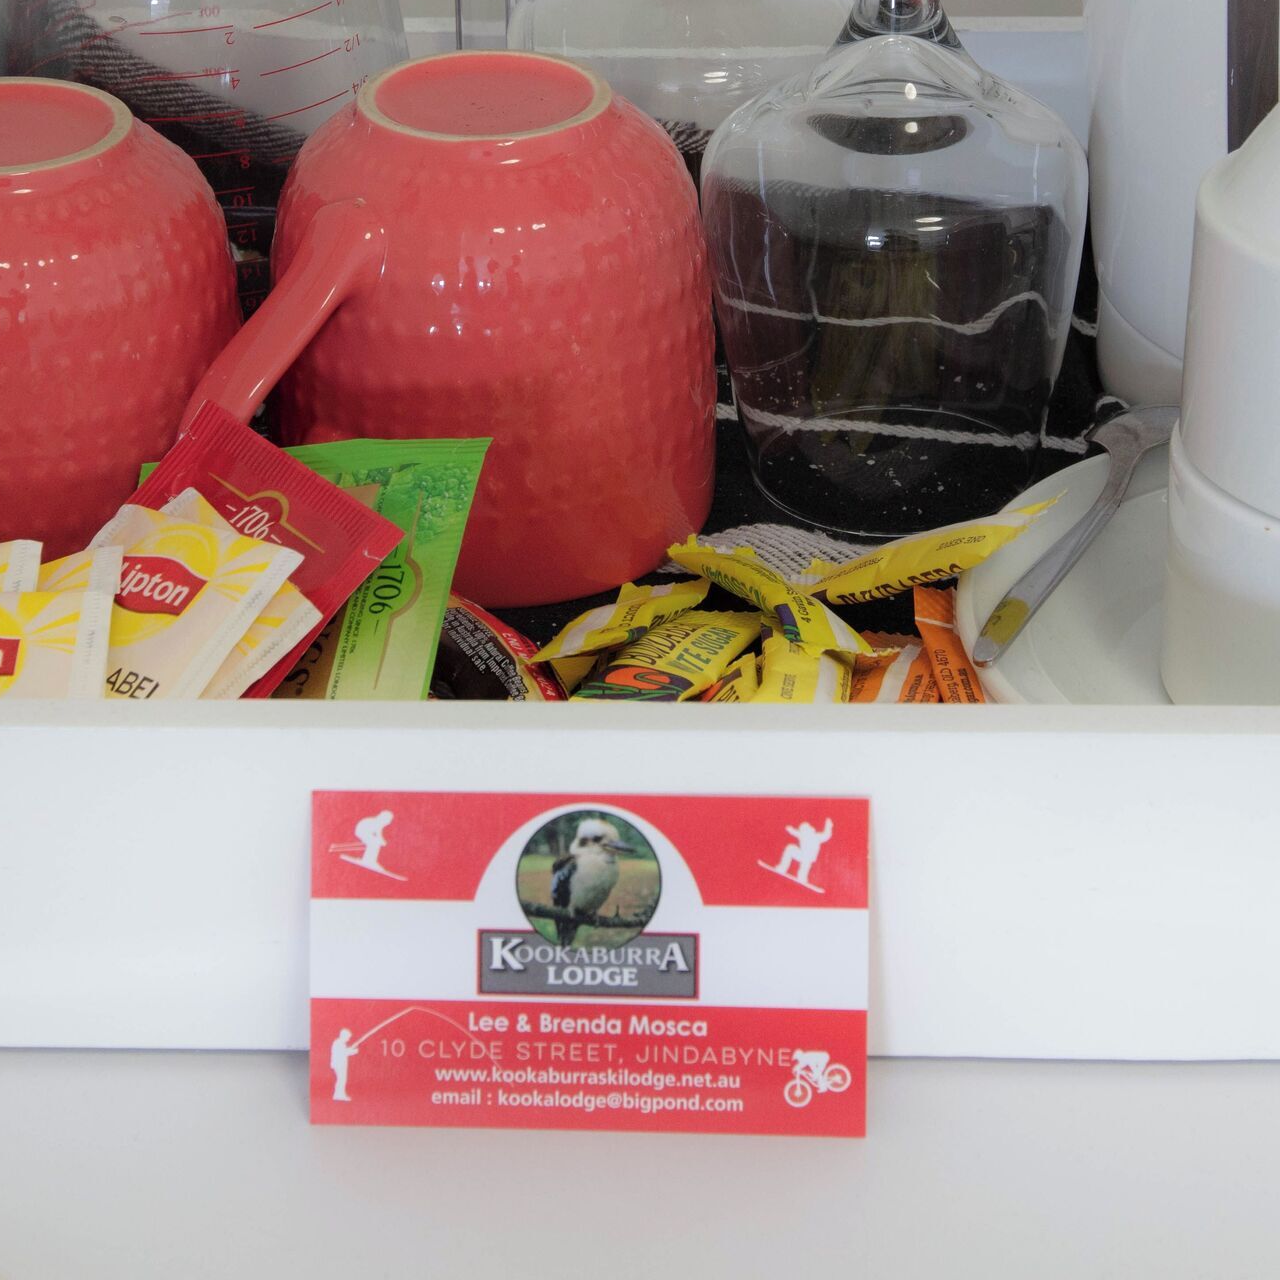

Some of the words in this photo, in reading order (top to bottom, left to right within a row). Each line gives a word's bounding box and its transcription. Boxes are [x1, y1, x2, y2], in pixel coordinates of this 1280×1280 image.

[225, 32, 235, 46] 2
[344, 32, 361, 53] 1/2
[231, 77, 240, 91] 4
[368, 563, 406, 615] 1706
[471, 655, 487, 675] sale.
[485, 641, 507, 665] Natural
[489, 936, 690, 972] KOOKABURRA
[546, 965, 639, 988] LODGE
[467, 1011, 510, 1034] Lee
[515, 1014, 532, 1034] &
[539, 1013, 622, 1035] Brenda
[628, 1015, 708, 1037] Mosca
[380, 1039, 407, 1058] 10
[417, 1040, 504, 1060] CLYDE
[515, 1041, 624, 1064] STREET,
[635, 1045, 790, 1067] JINDABYNE
[434, 1066, 741, 1090] www.kookaburraskilodge.net.au
[431, 1089, 482, 1106] email
[497, 1089, 745, 1113] kookalodge@bigpond.com
